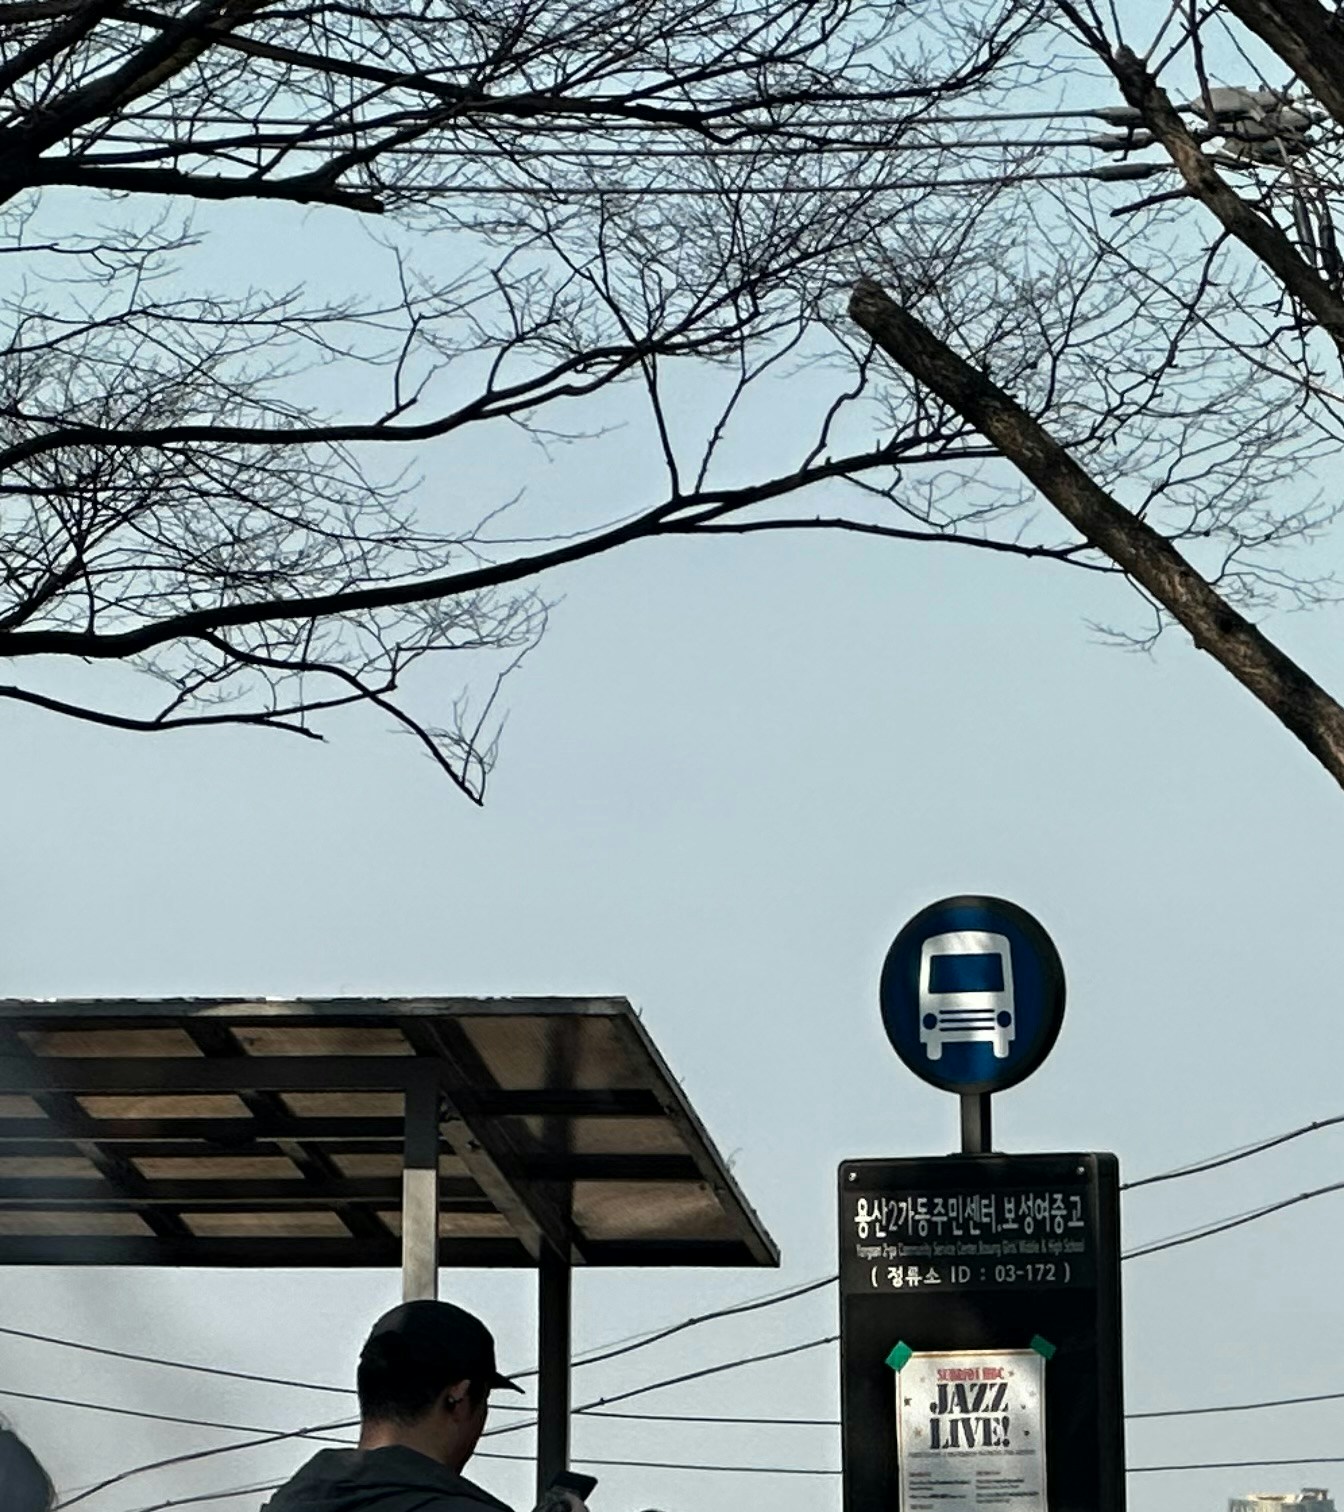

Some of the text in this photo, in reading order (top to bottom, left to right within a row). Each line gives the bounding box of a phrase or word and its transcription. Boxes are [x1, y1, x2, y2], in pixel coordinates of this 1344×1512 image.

[887, 1265, 942, 1288] 정류소
[951, 1264, 971, 1284] ID
[995, 1263, 1057, 1284] 03-172
[929, 1382, 1009, 1415] JAZZ
[929, 1416, 1011, 1449] LIVE!
